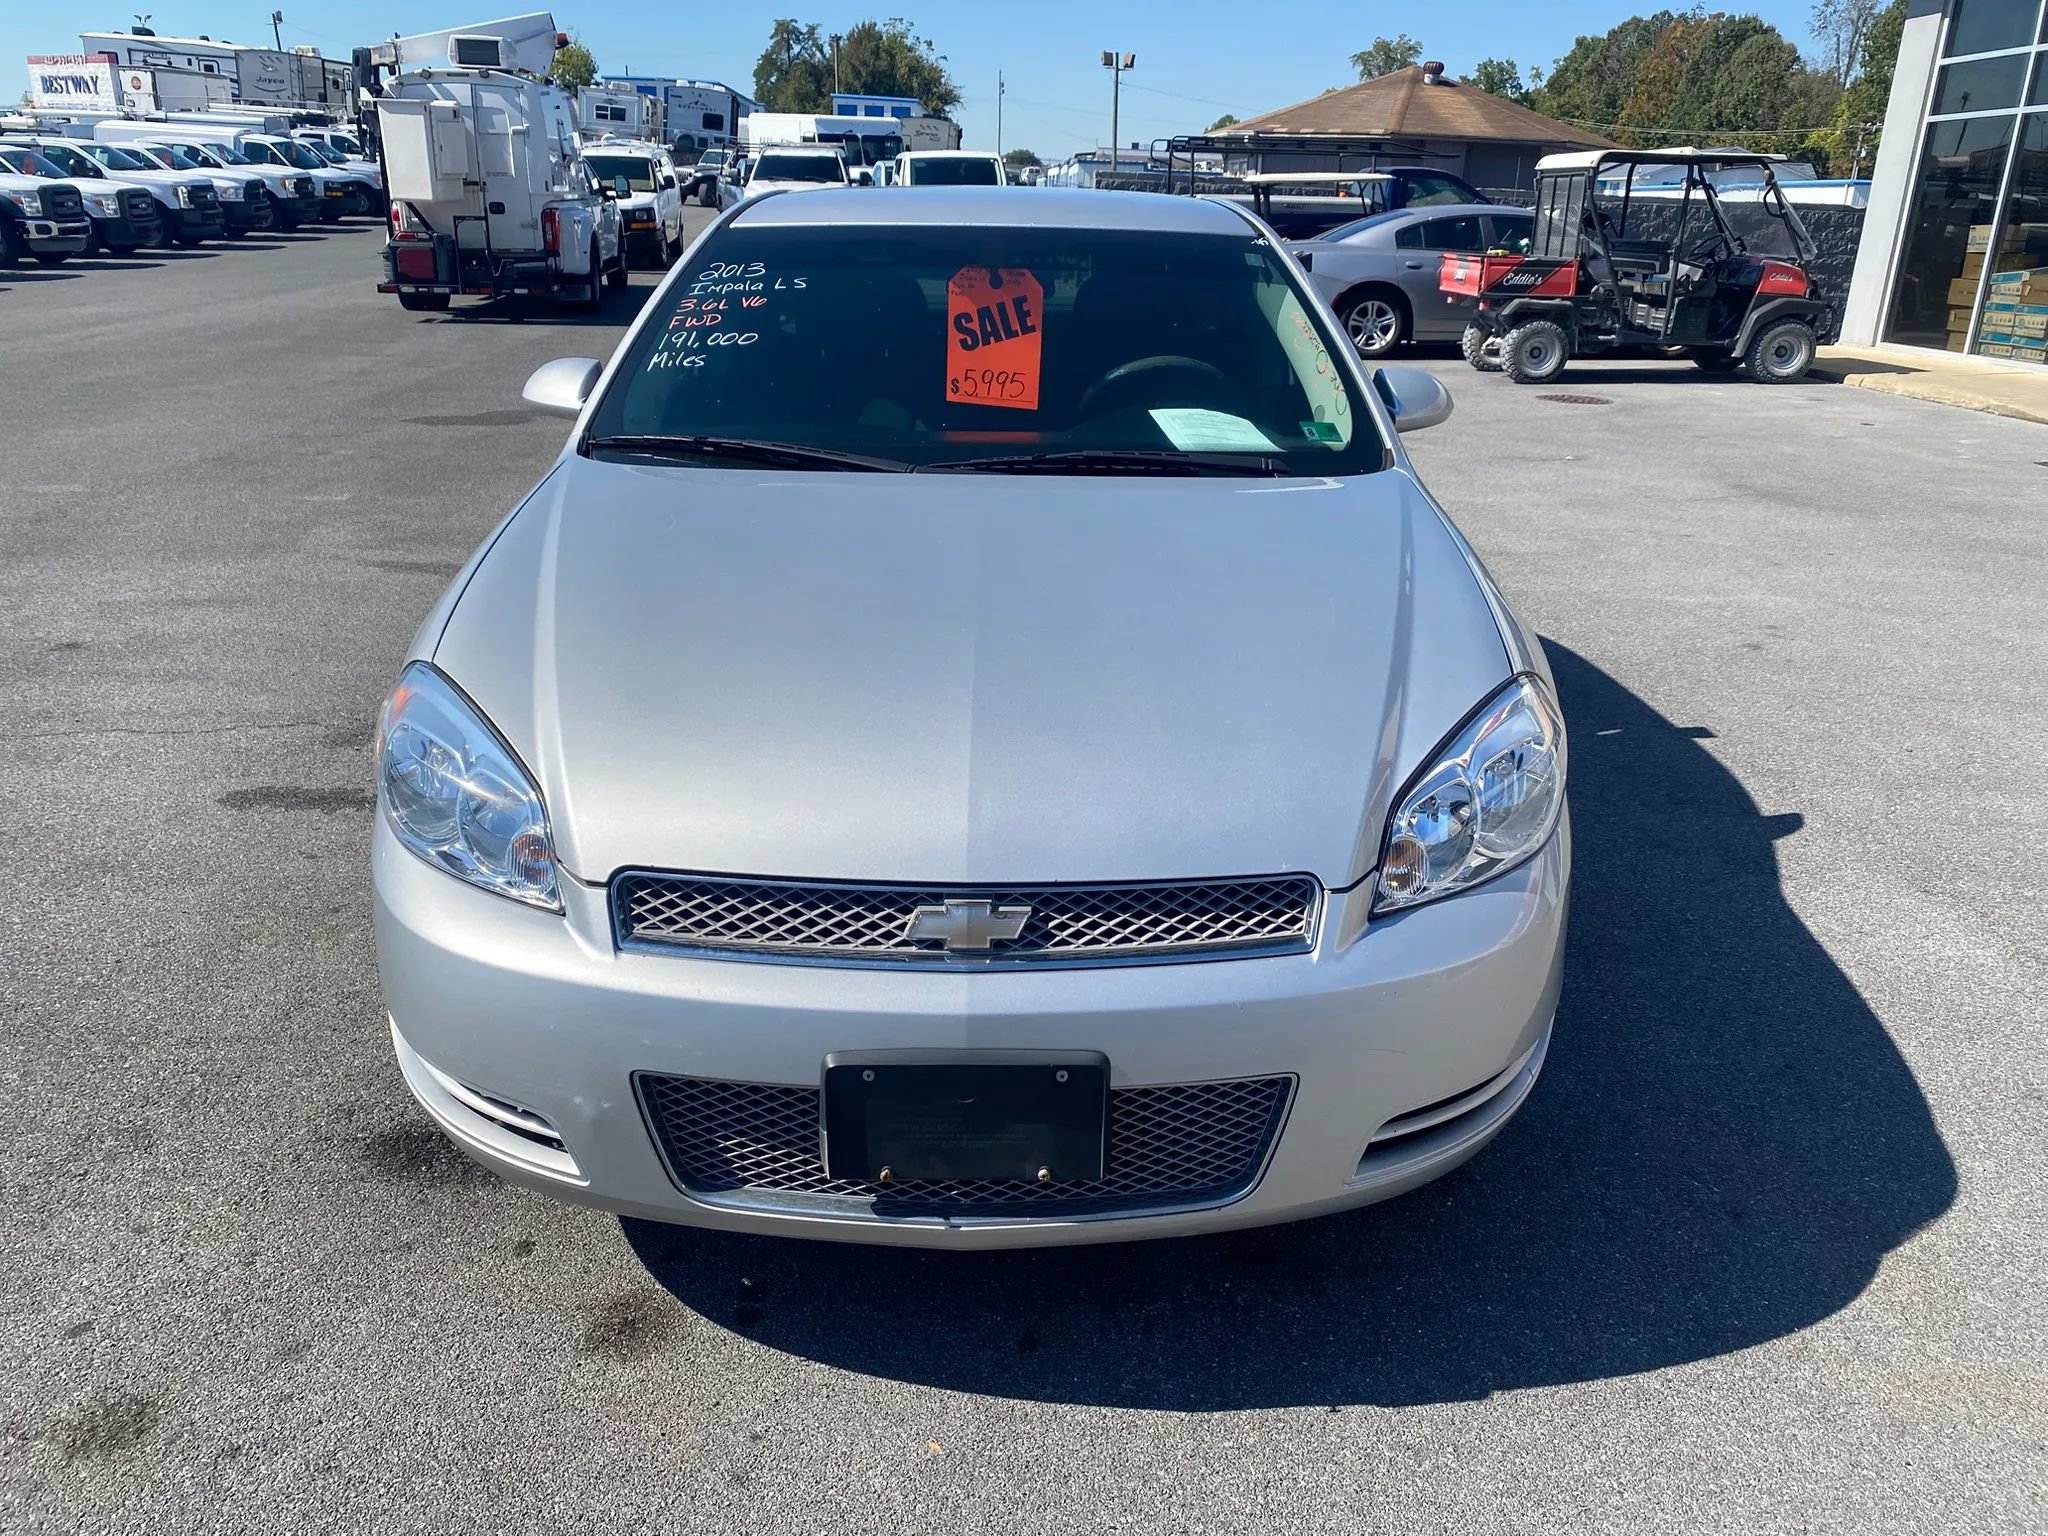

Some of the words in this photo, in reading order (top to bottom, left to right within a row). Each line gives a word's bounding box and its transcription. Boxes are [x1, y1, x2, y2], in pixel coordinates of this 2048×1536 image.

[41, 75, 99, 95] BESTWAY
[699, 262, 766, 280] 2013
[1503, 272, 1542, 287] Eddie's
[688, 280, 764, 296] Impala
[677, 298, 729, 312] 3.6L
[741, 296, 768, 308] V6
[669, 313, 722, 329] FWD
[953, 295, 1036, 351] SALE
[658, 331, 759, 350] 191,000
[647, 352, 706, 372] Miles
